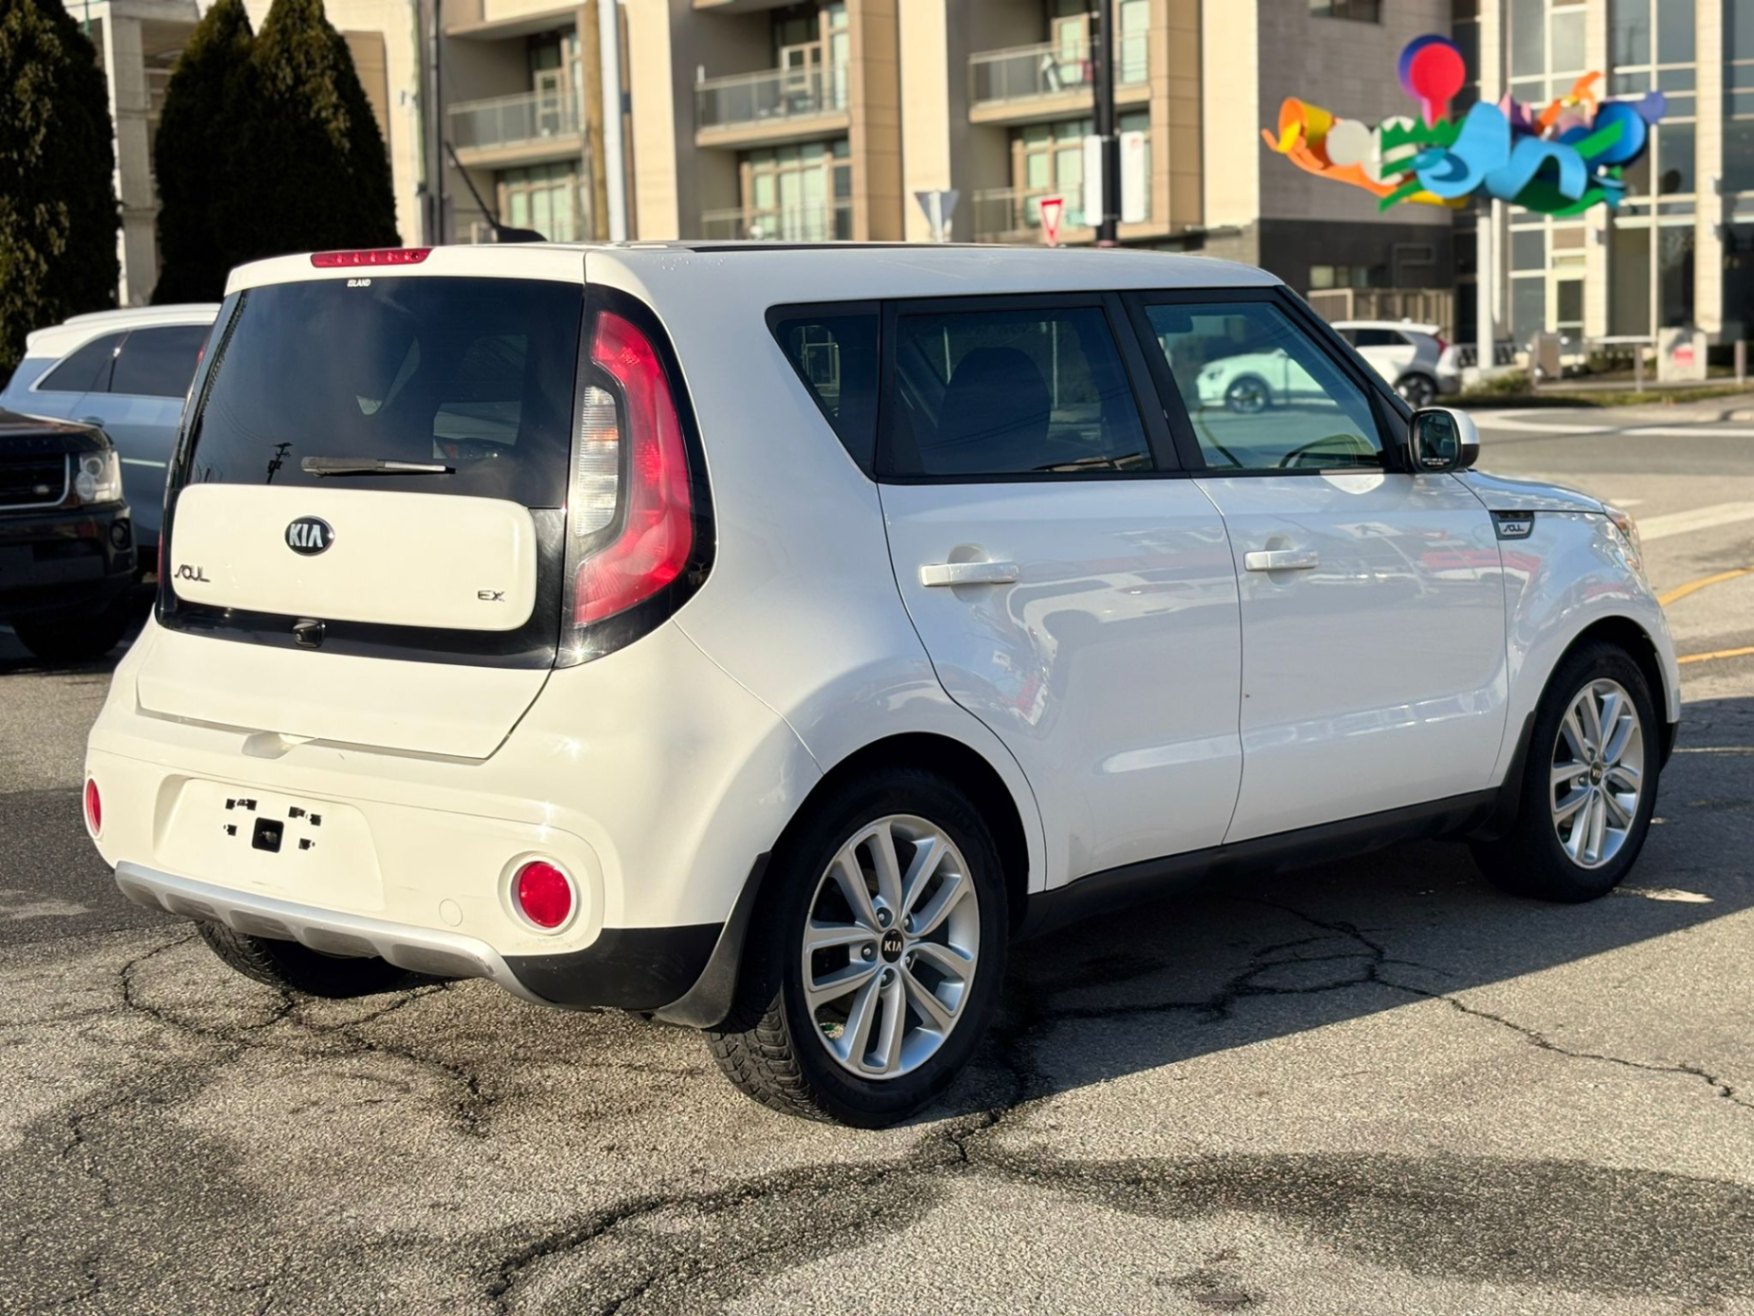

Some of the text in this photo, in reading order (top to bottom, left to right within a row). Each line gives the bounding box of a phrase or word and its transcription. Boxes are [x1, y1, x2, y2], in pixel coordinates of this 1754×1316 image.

[289, 523, 324, 548] KIA
[477, 590, 506, 602] EX
[884, 940, 902, 952] KIA
